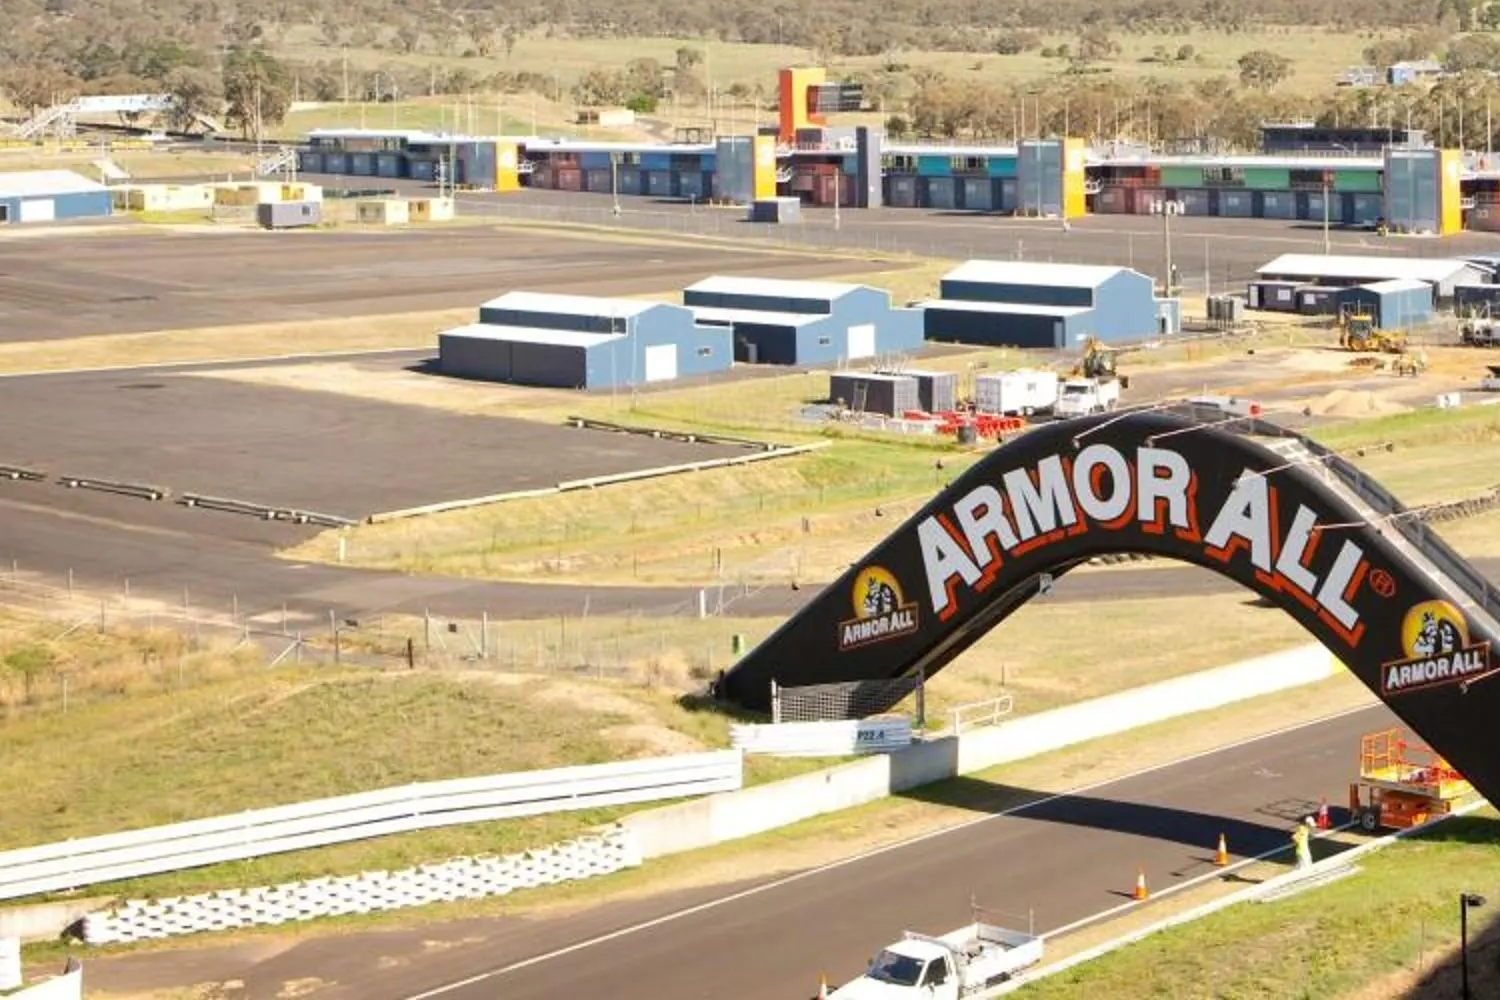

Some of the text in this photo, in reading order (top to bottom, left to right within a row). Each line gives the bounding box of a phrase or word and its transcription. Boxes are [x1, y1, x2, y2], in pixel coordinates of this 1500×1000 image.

[917, 444, 1366, 637] ARMOR ALL
[843, 610, 914, 646] ARMOR ALL
[1387, 650, 1484, 689] ARMOR ALL
